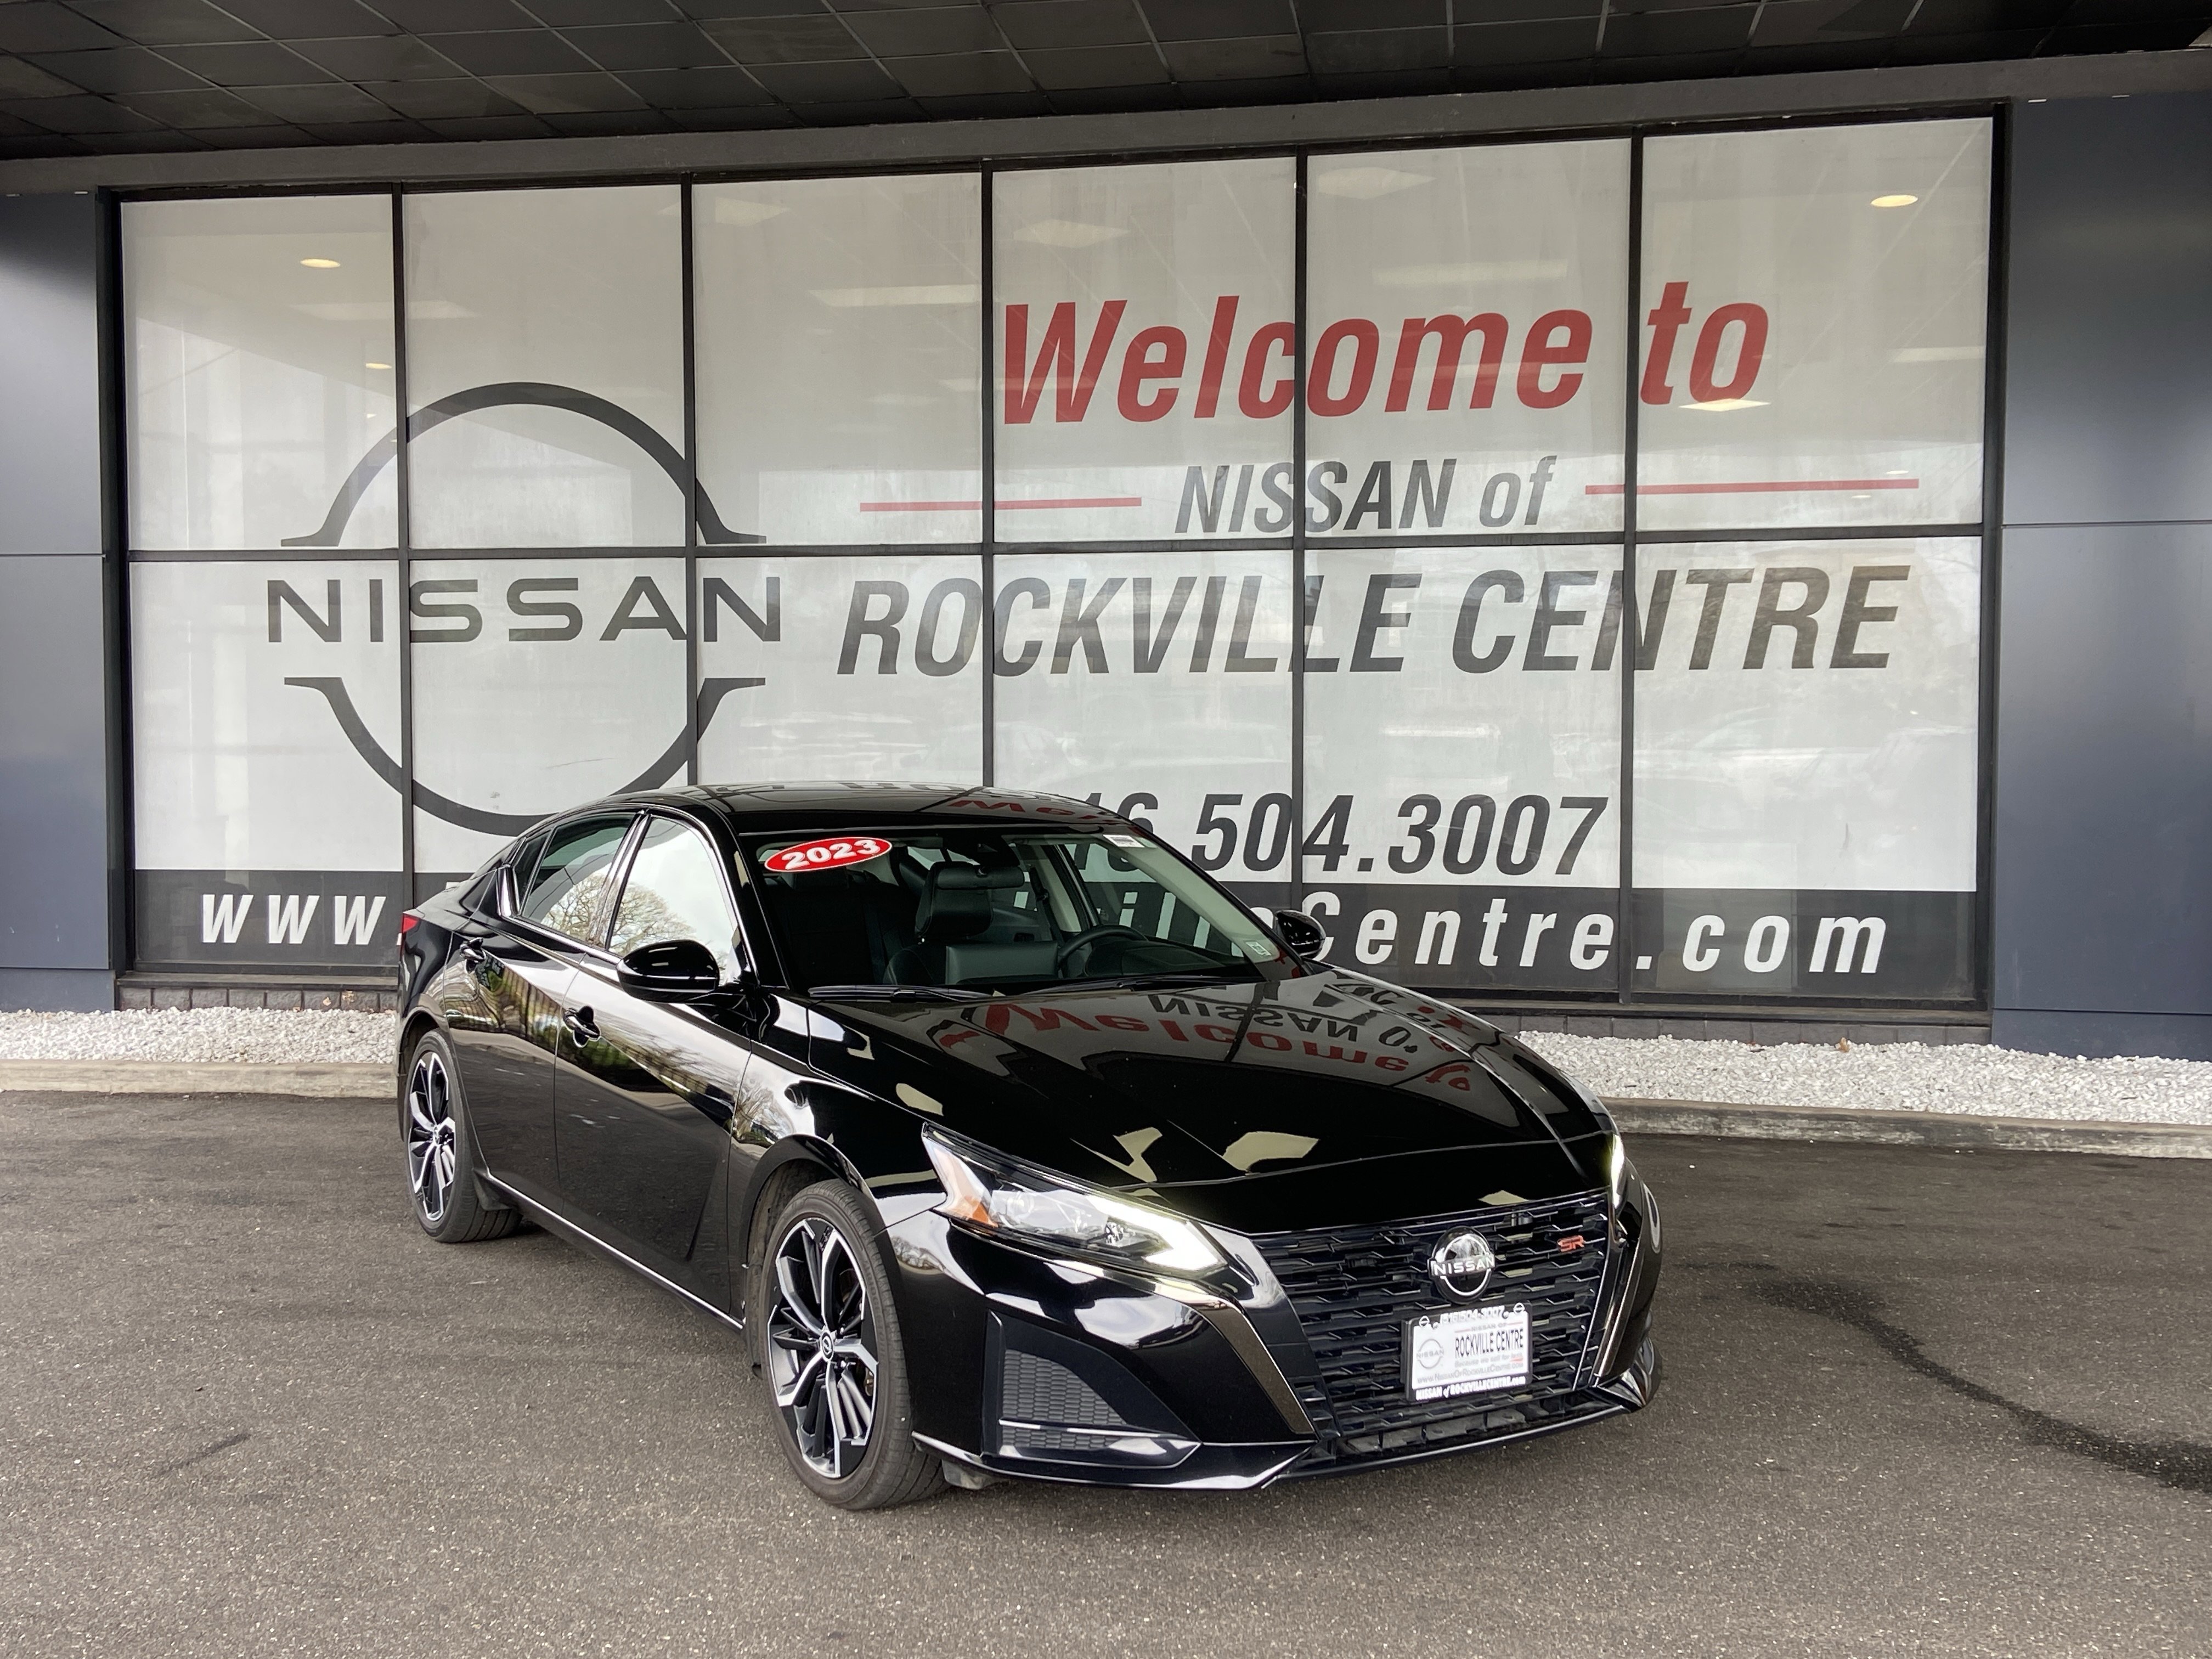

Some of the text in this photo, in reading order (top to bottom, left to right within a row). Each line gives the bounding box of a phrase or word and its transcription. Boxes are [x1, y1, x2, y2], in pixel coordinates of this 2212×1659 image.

[1005, 281, 1768, 425] Welcome to
[1175, 456, 1557, 534] NISSAN of
[267, 576, 781, 643] NISSAN
[837, 566, 1910, 677] ROCKVILLE CENTRE
[781, 839, 881, 870] 2023
[1558, 1235, 1584, 1252] SR
[1431, 1256, 1495, 1276] NISSAN
[1417, 1349, 1444, 1358] NISSAN
[1455, 1327, 1523, 1358] ROCKVILLE CENTRE
[1416, 1387, 1442, 1400] NISSAN
